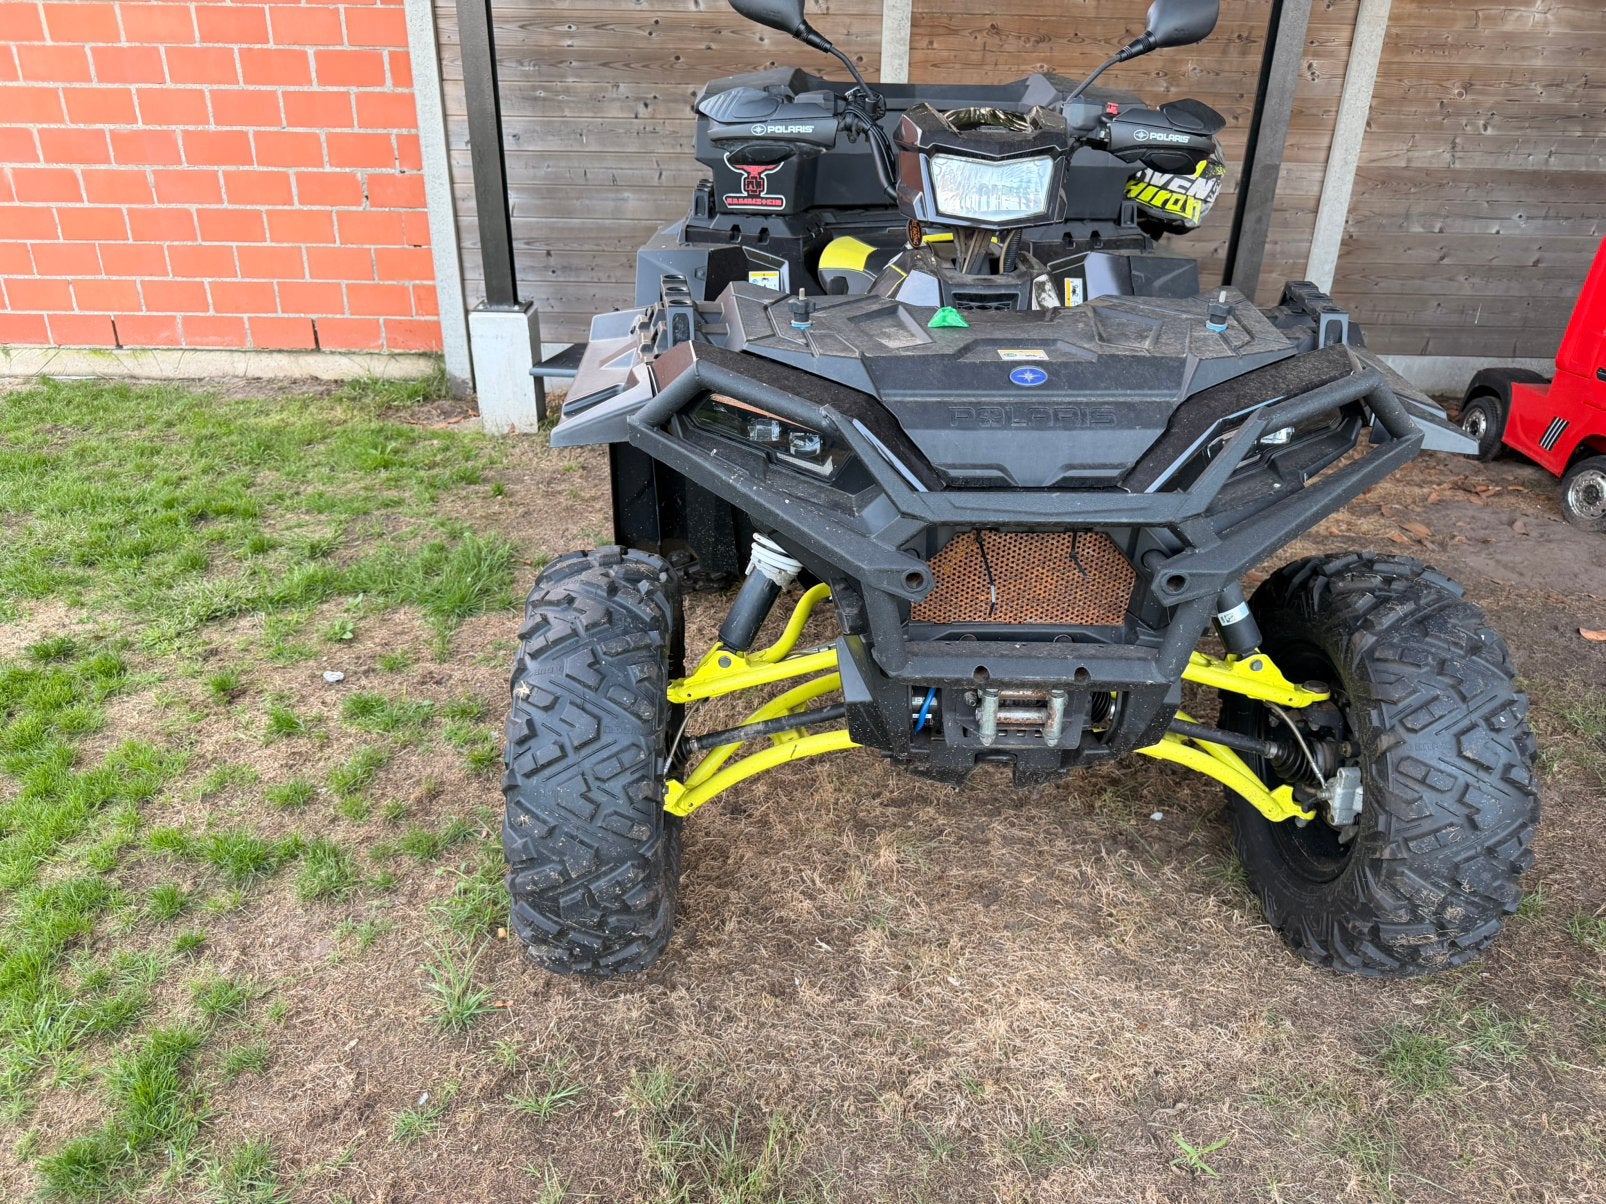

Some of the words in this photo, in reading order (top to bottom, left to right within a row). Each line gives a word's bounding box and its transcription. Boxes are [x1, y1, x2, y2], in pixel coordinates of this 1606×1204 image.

[767, 125, 815, 134] POLARIS
[1149, 132, 1189, 143] POLARIS
[949, 405, 1118, 428] POLARIS
